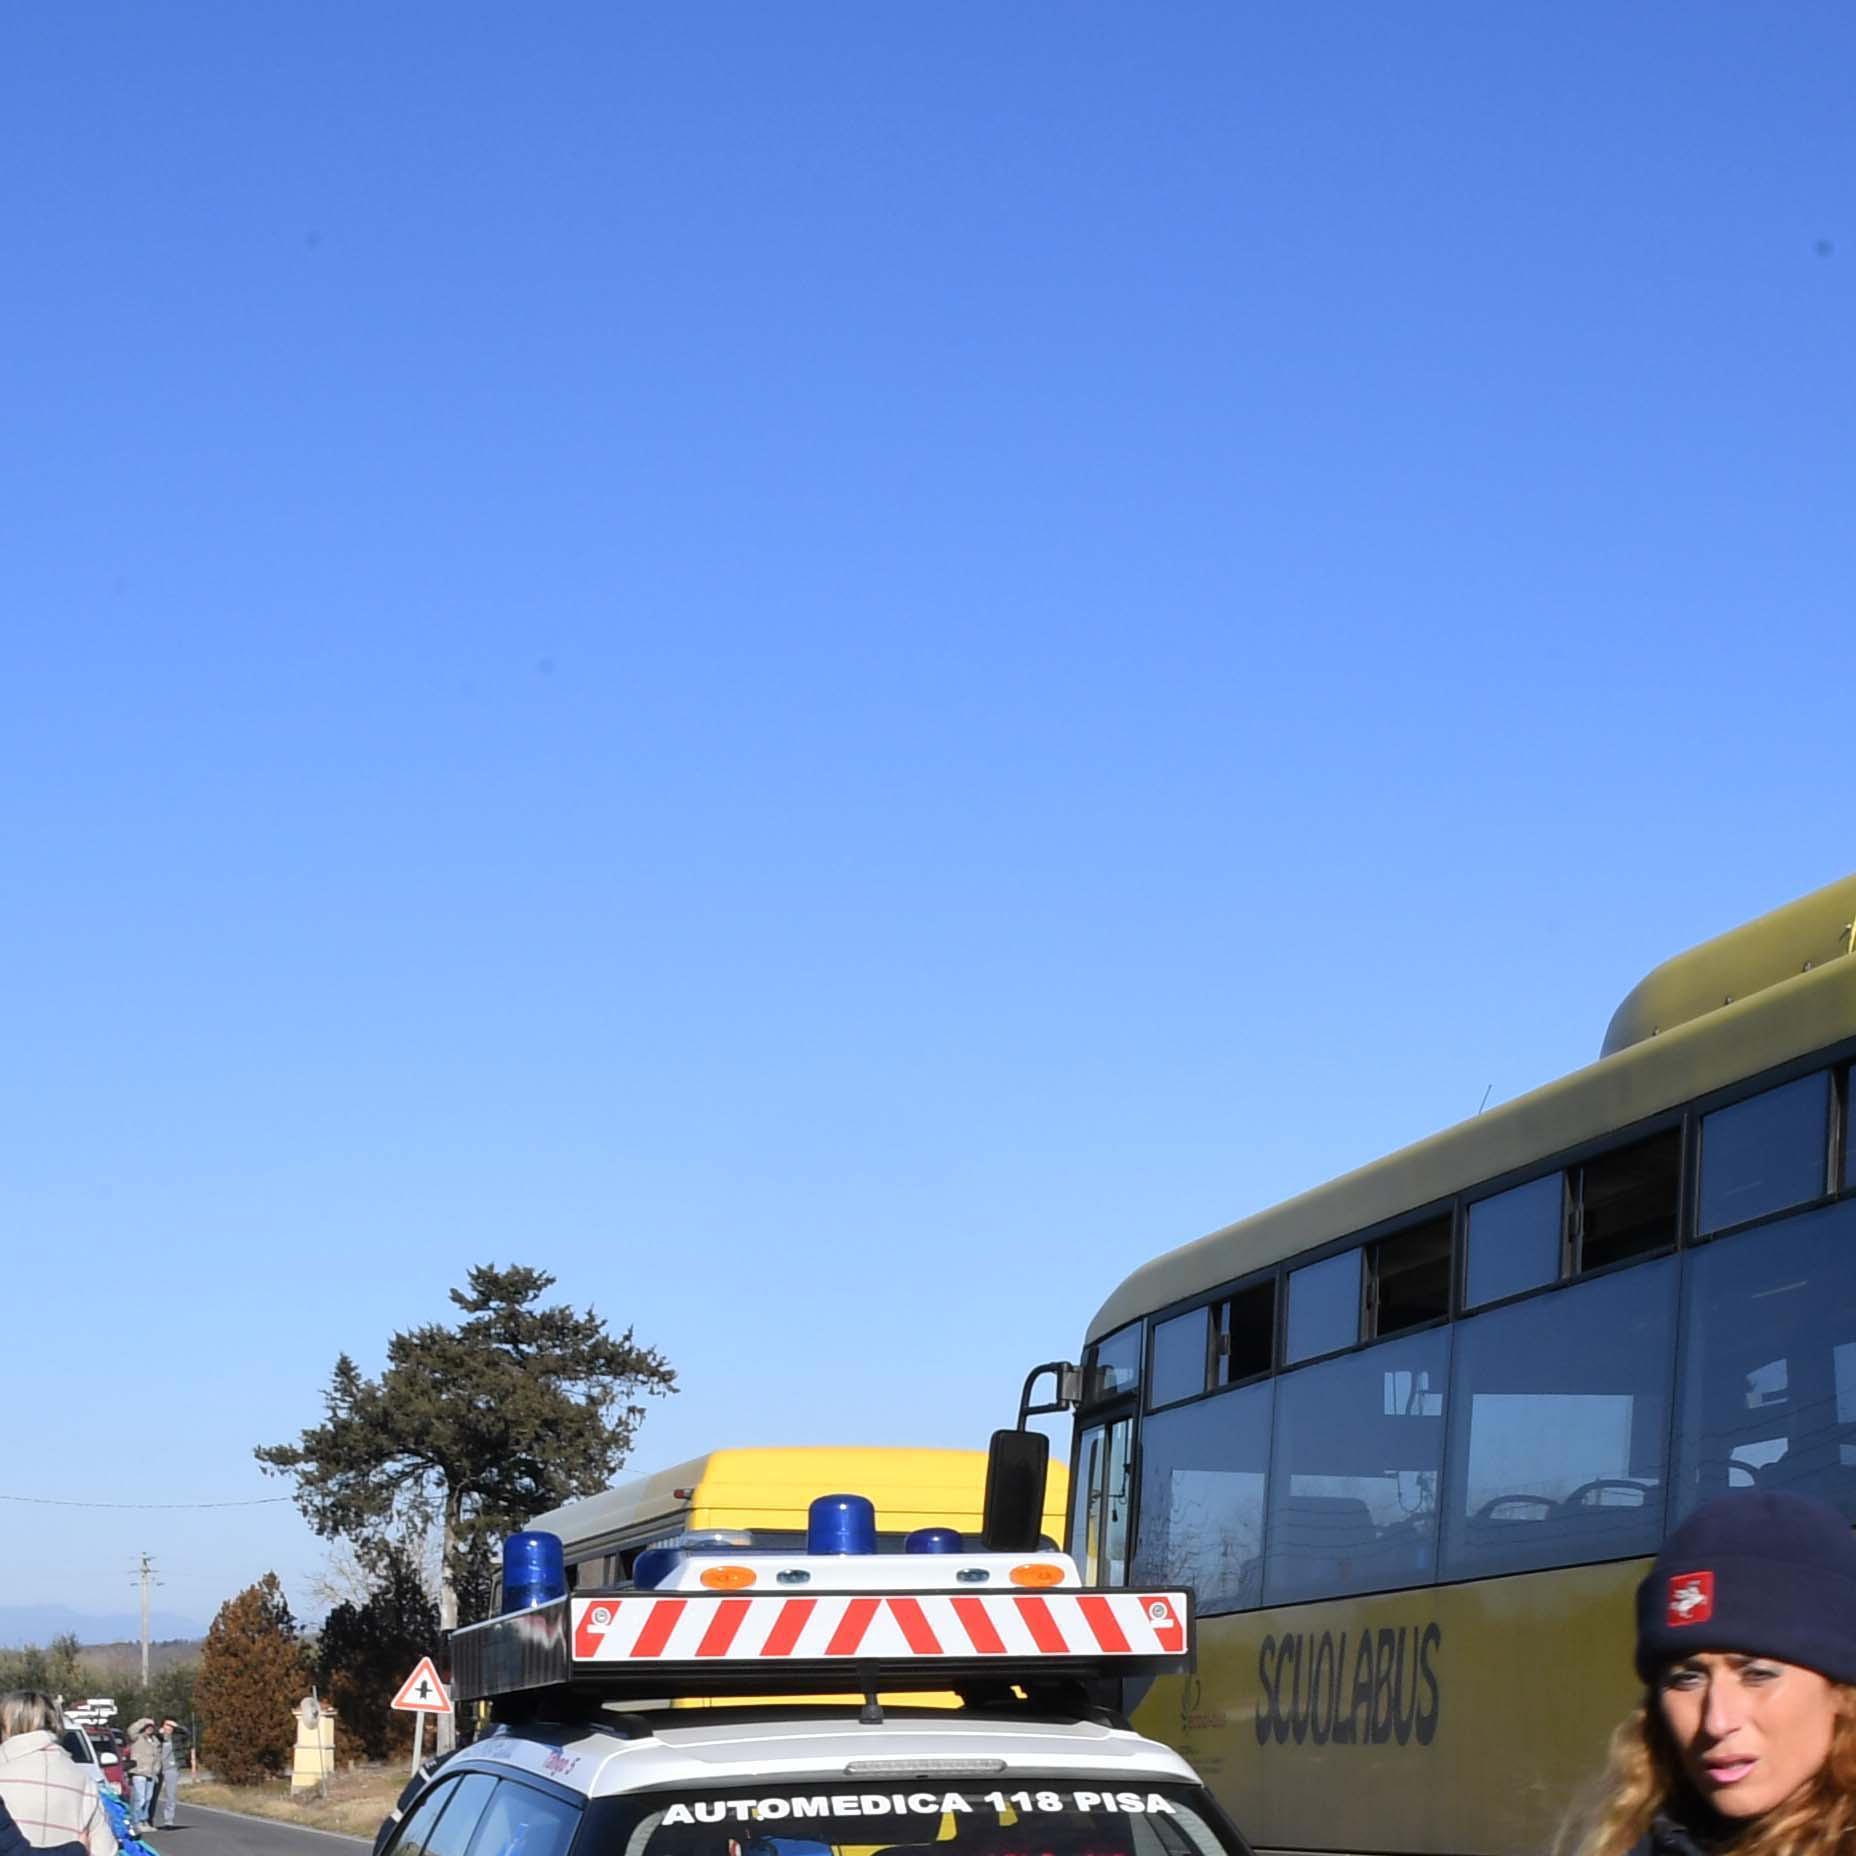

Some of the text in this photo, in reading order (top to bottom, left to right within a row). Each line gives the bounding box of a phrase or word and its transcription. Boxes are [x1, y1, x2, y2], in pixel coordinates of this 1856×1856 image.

[1256, 1622, 1441, 1746] SCUOLABUS
[661, 1791, 1176, 1826] AUTOMEDICA 118 PISA
